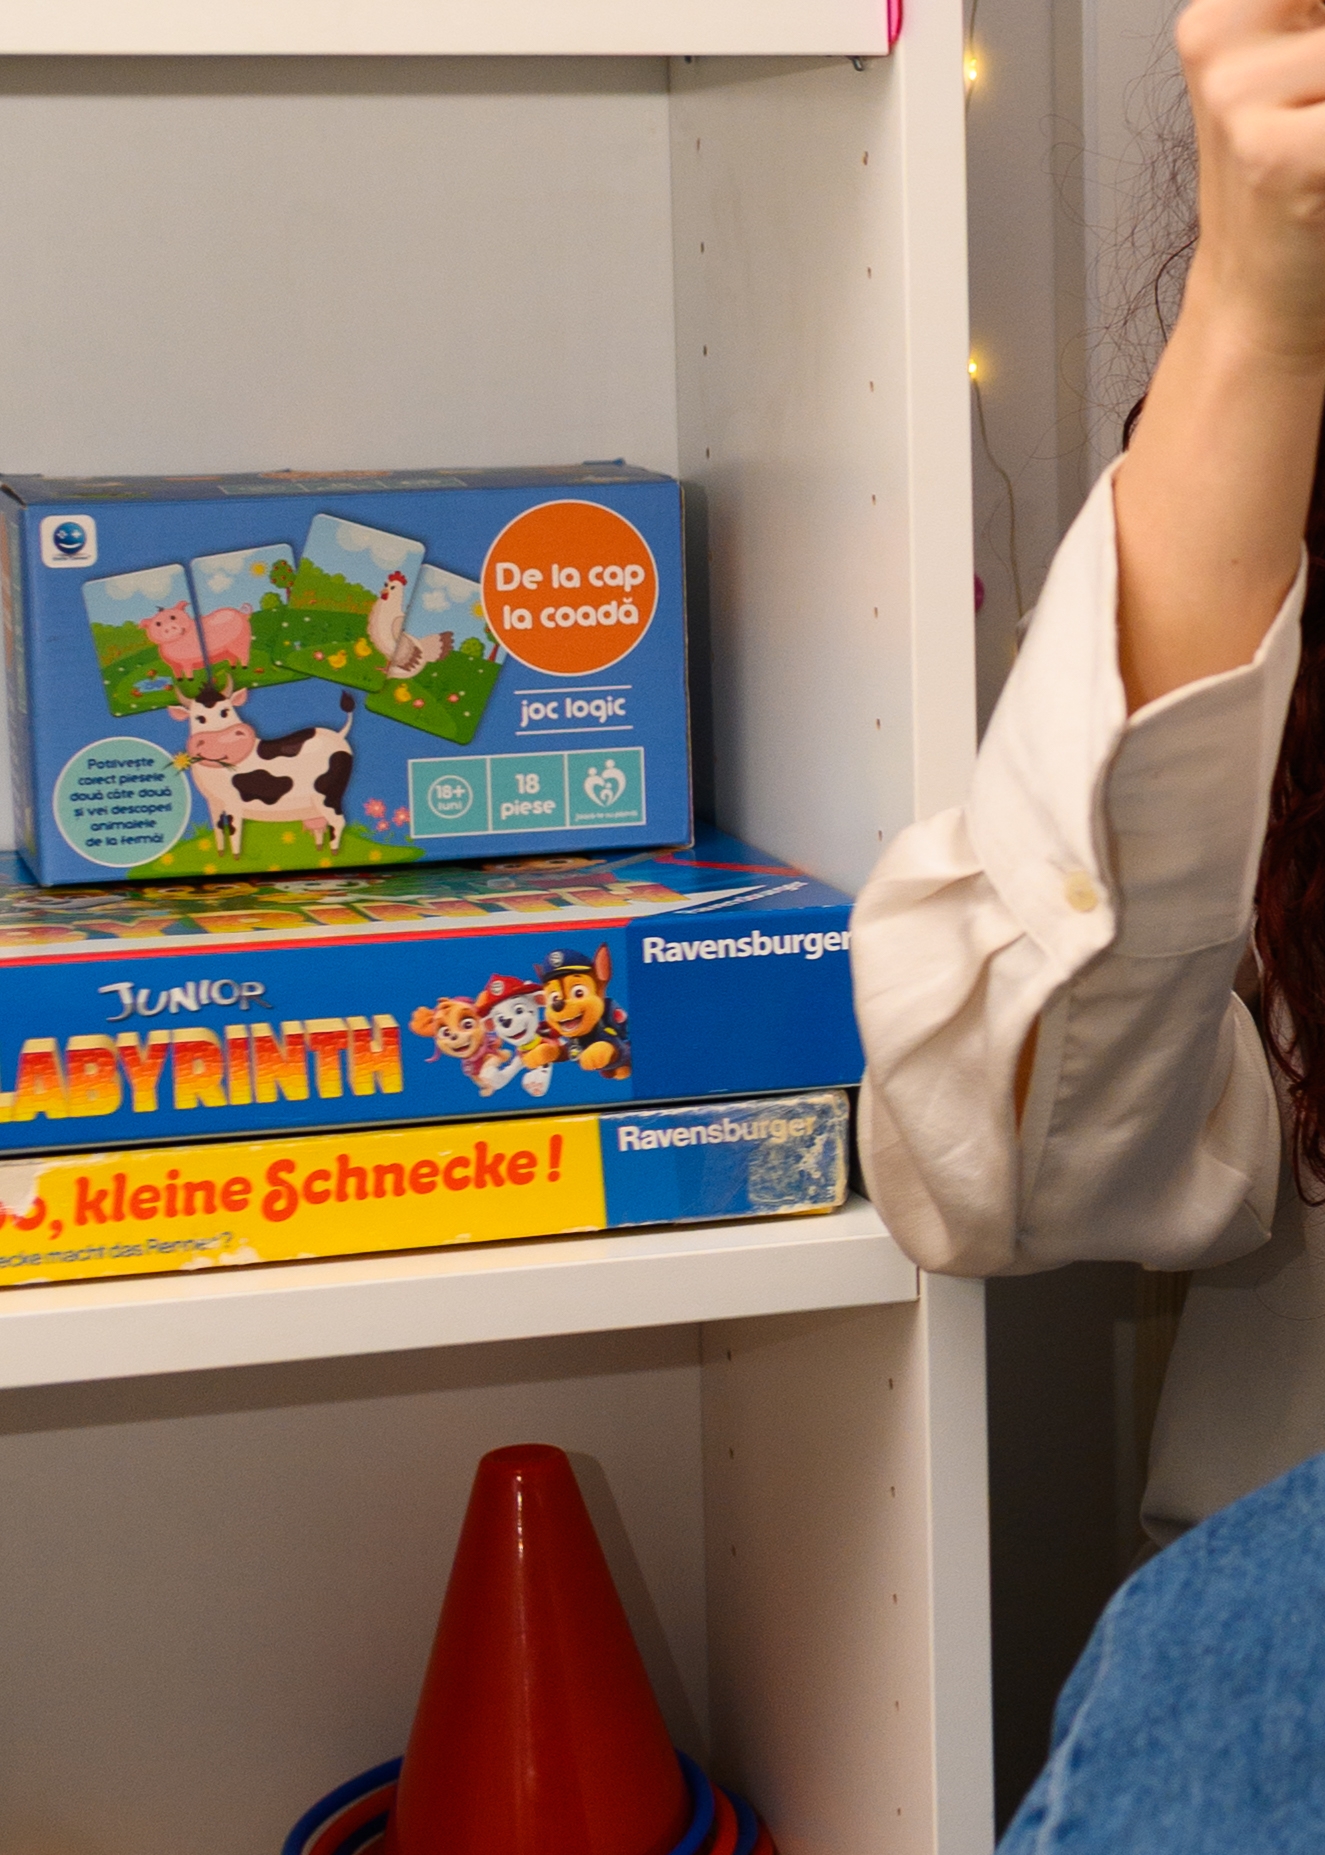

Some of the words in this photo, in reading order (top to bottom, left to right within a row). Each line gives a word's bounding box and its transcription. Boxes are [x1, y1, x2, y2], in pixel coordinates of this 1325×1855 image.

[495, 562, 543, 591] De
[551, 564, 581, 588] la
[587, 564, 646, 592] cap
[503, 605, 533, 630] la
[540, 597, 639, 628] coadă
[520, 699, 559, 727] joc
[565, 695, 626, 723] logic
[435, 784, 466, 799] 18+
[515, 773, 540, 794] 18
[501, 799, 557, 820] piese
[642, 929, 850, 964] Ravensburger
[98, 978, 273, 1022] JUNIOR
[618, 1115, 816, 1152] Ravensburger
[74, 1168, 253, 1226] kleine
[109, 1241, 144, 1259] das
